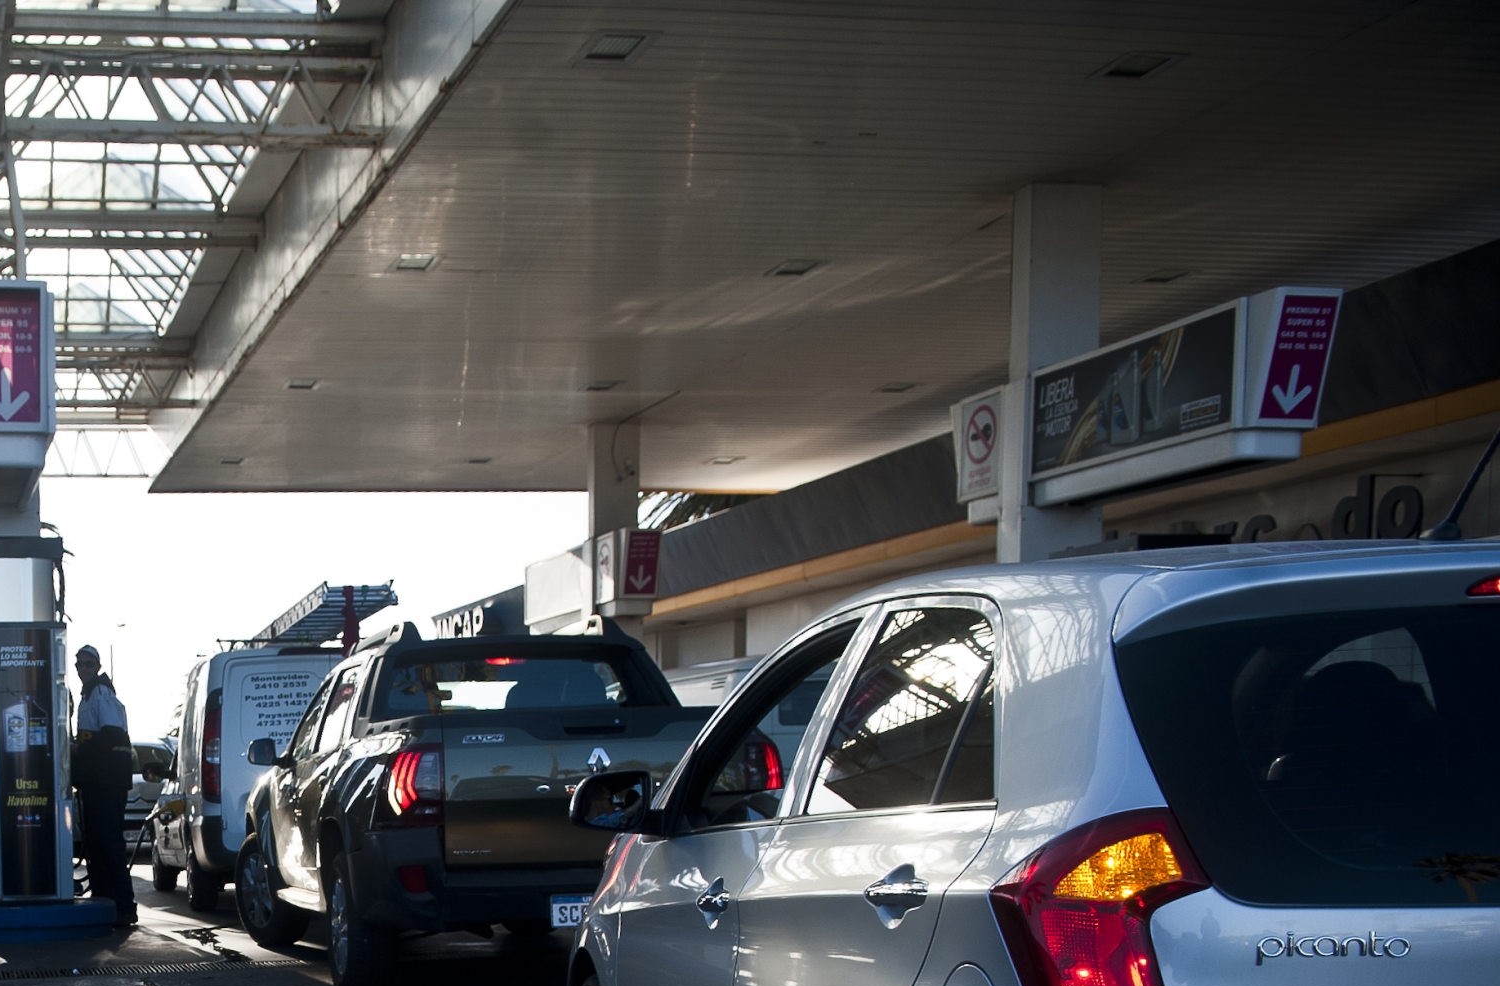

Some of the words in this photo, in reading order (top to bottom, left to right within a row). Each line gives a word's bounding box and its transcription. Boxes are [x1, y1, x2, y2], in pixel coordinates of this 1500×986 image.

[1286, 306, 1320, 314] PREMIUM
[16, 319, 28, 327] 95
[1287, 318, 1313, 326] SUPER
[1297, 331, 1308, 339] OIL
[1279, 342, 1293, 350] GAS
[1294, 342, 1306, 350] OIL
[251, 674, 310, 682] Montevideo
[282, 681, 307, 689] 2535
[16, 779, 38, 789] Ursa
[7, 796, 48, 806] Havoline
[1256, 930, 1412, 966] picanto
